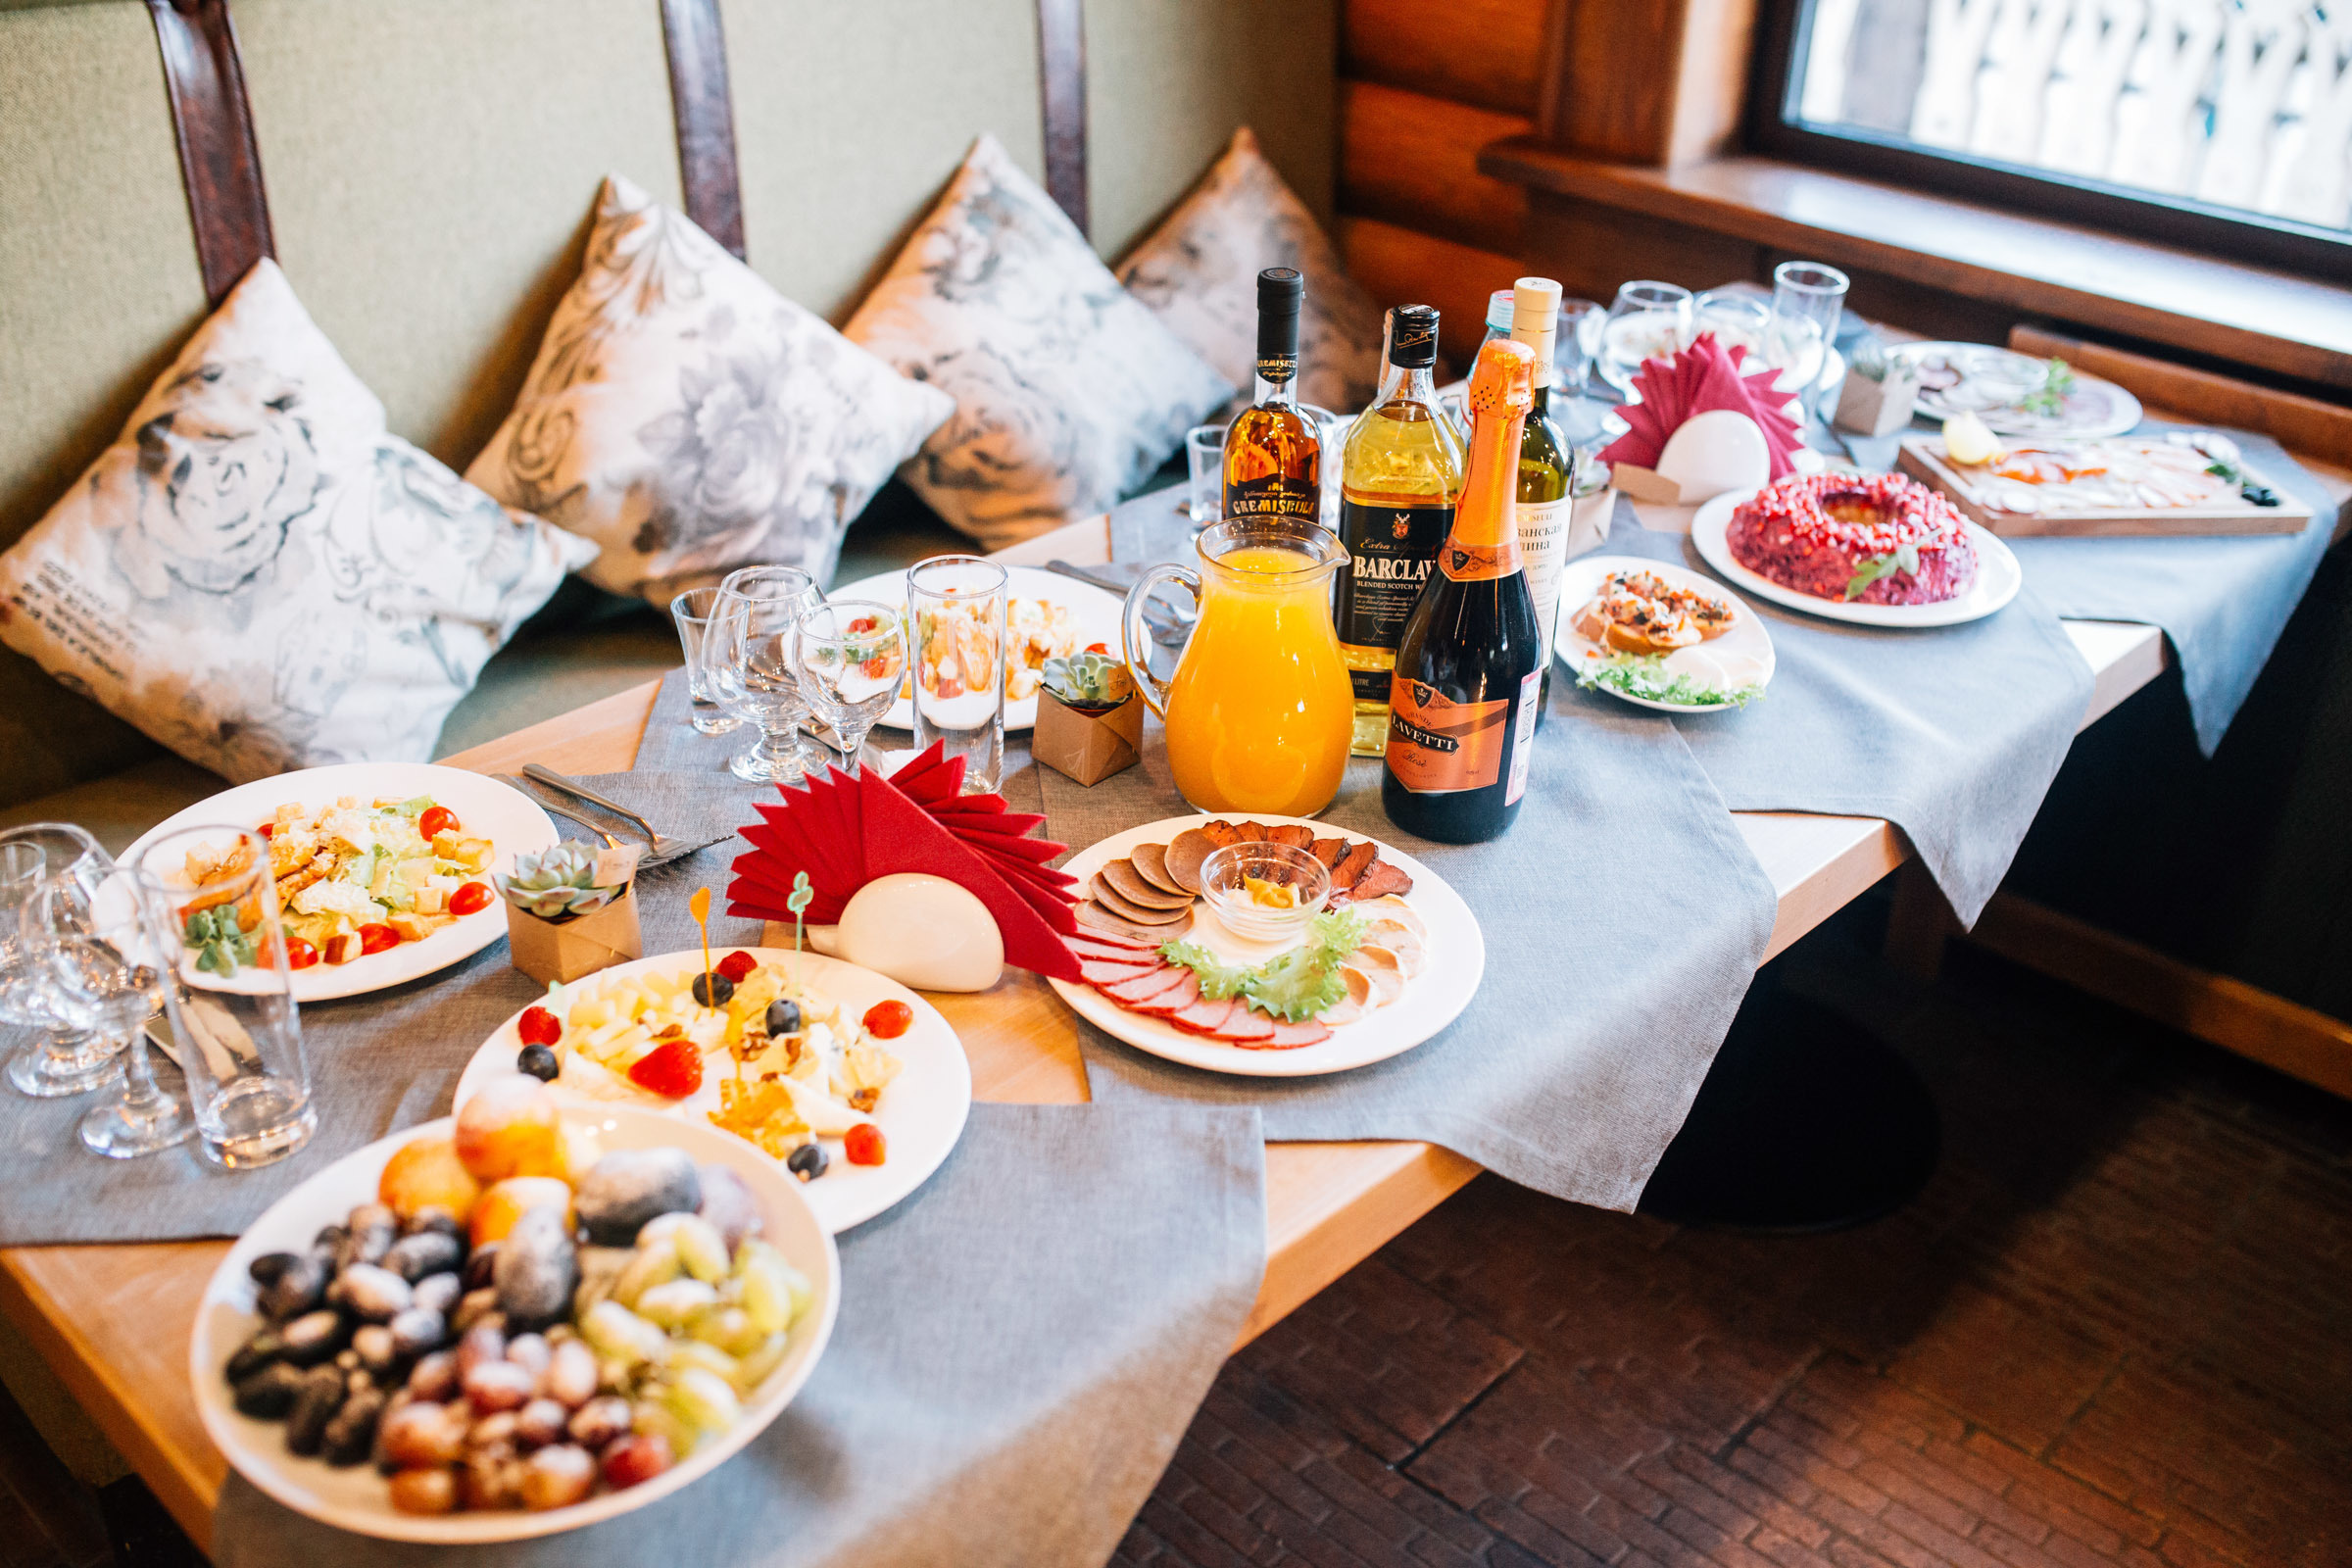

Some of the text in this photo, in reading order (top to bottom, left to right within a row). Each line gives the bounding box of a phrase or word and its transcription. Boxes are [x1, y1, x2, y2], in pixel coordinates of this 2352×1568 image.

[1360, 537, 1391, 550] Extra
[1519, 541, 1549, 552] лина
[1356, 580, 1387, 590] BLENDED
[1405, 712, 1434, 729] GRANDE
[1393, 714, 1454, 751] LAVETTI
